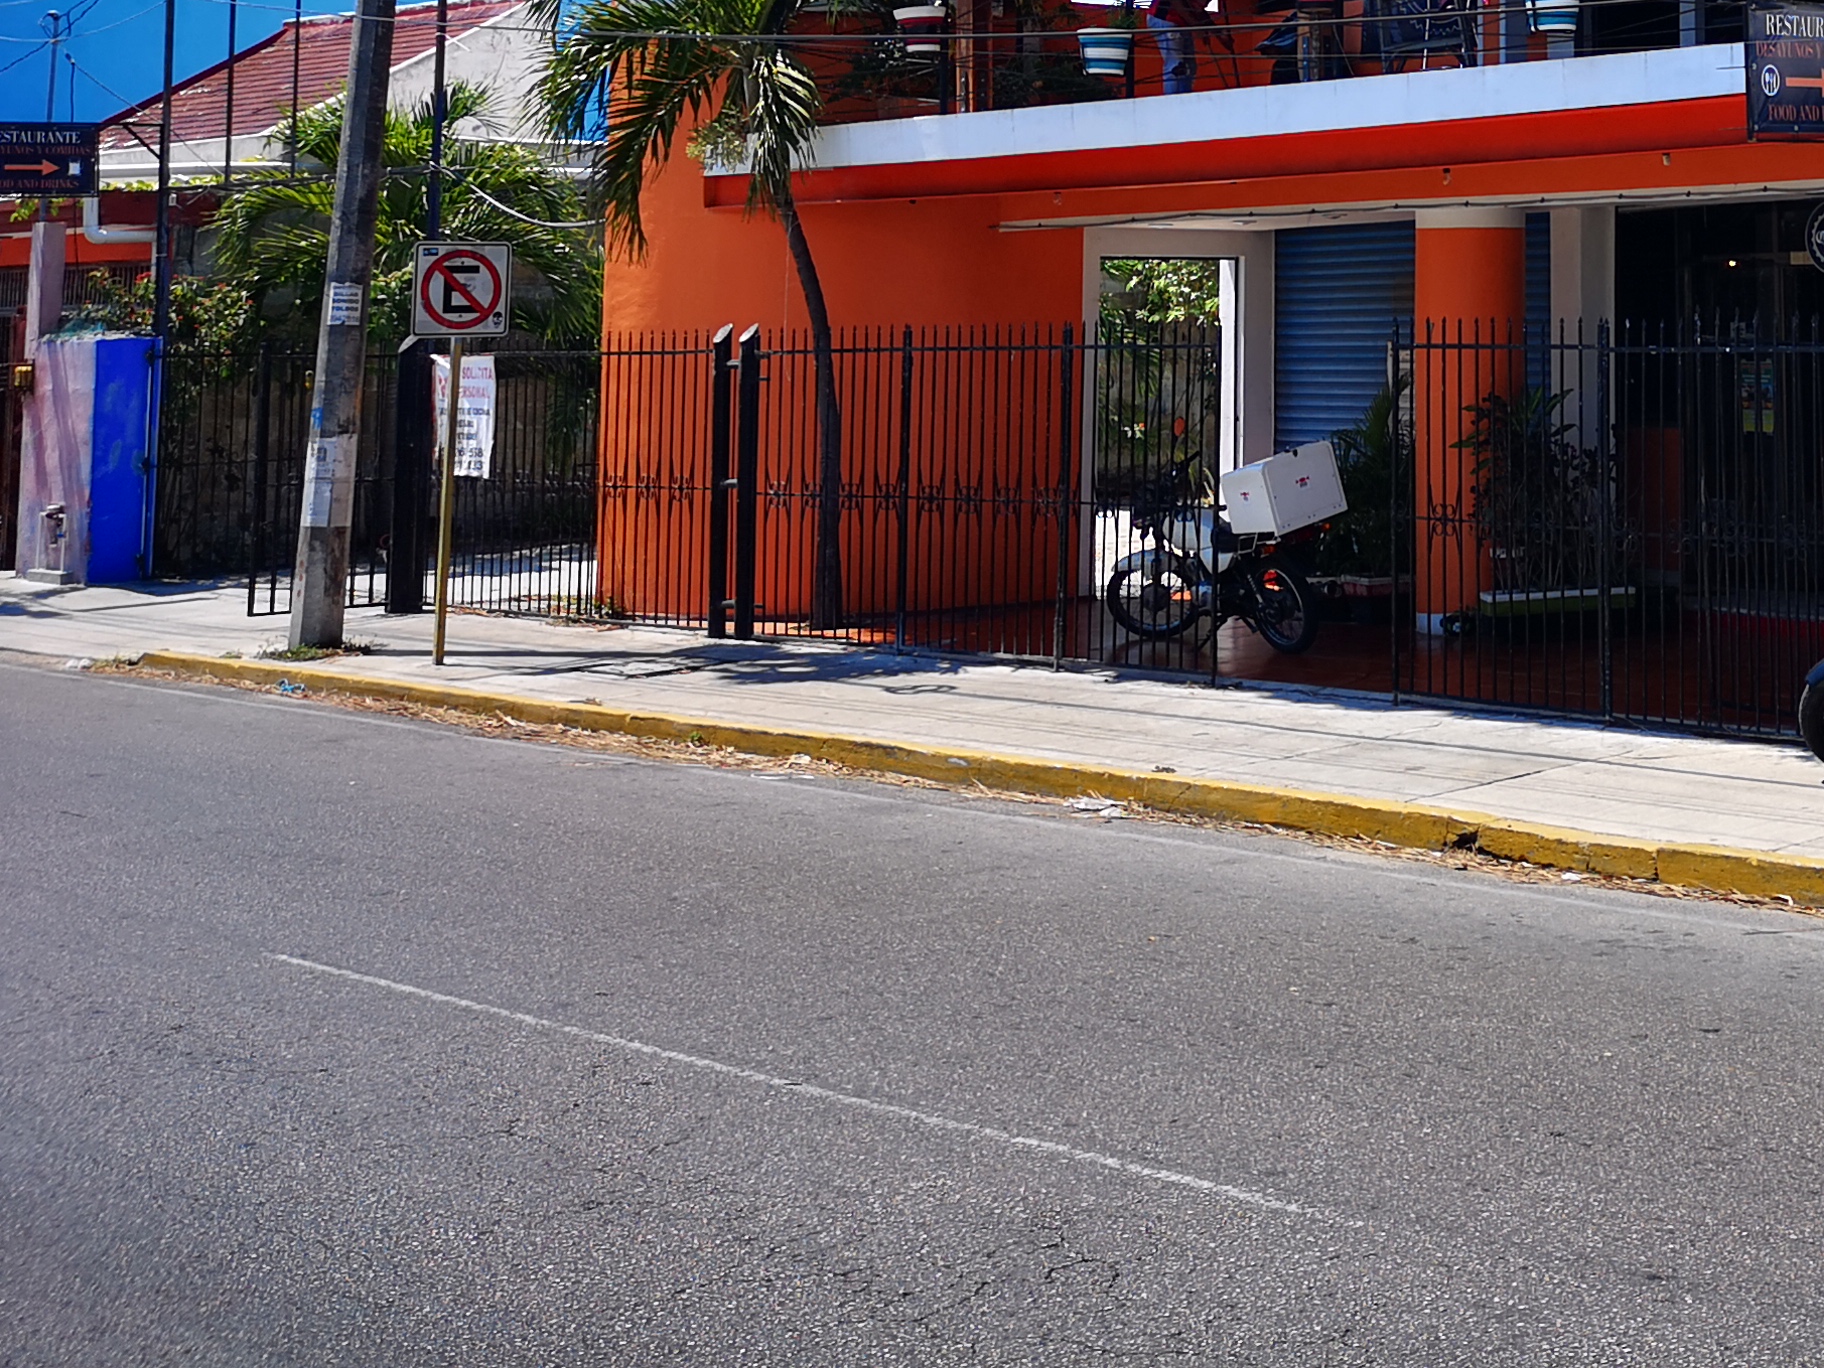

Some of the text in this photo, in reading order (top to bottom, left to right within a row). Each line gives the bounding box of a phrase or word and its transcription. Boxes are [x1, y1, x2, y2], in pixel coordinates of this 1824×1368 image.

[1767, 104, 1797, 121] FOOD
[1799, 105, 1820, 120] AND
[17, 179, 39, 188] AND
[41, 179, 79, 188] DRINKS
